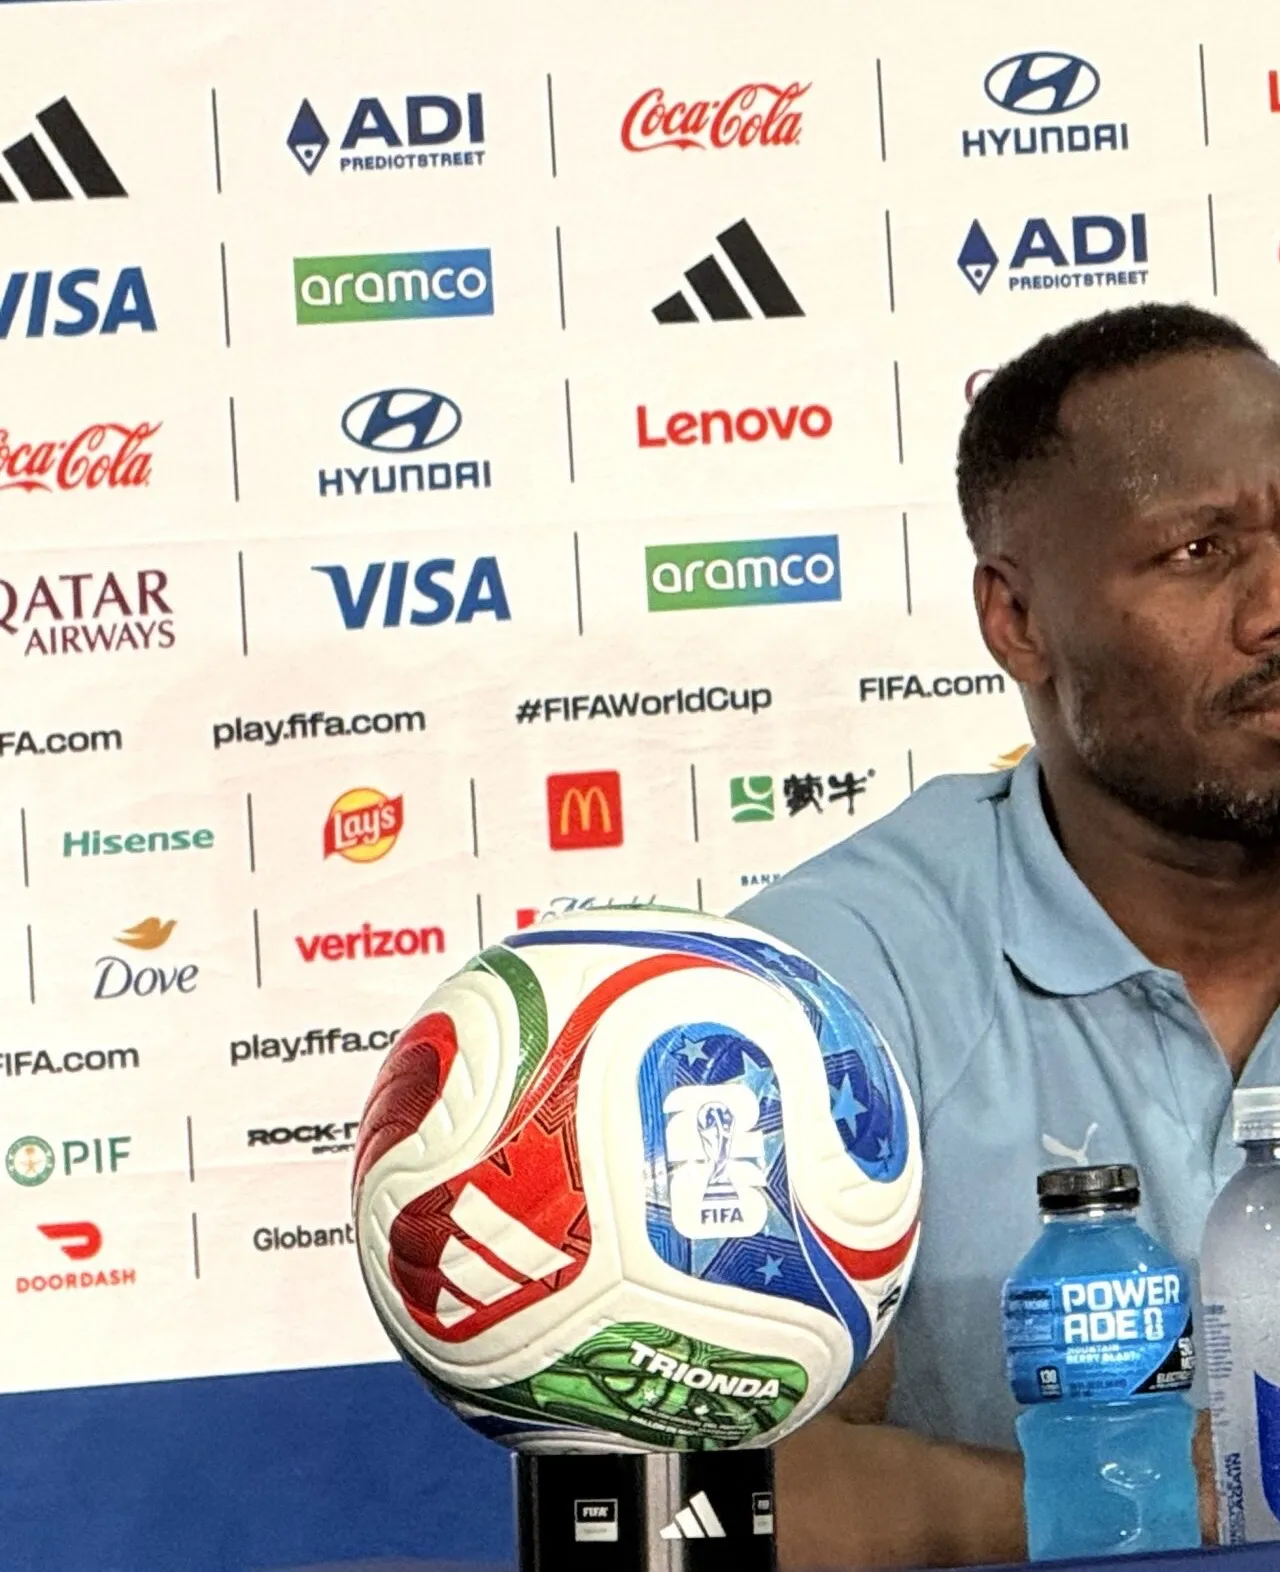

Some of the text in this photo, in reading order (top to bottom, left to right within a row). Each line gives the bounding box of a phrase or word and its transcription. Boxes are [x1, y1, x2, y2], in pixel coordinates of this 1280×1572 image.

[339, 92, 485, 151] ADI
[620, 81, 812, 153] Coca-Cola
[962, 122, 1129, 158] HYUNDAI
[1008, 213, 1149, 270] ADI
[301, 264, 488, 308] aramco
[636, 403, 833, 449] Lenovo
[318, 460, 492, 497] HYUNDAI
[310, 555, 512, 630] VISA
[652, 552, 835, 594] aramco
[24, 619, 176, 656] AIRWAYS
[515, 686, 773, 725] #FIFAWorldCup
[859, 673, 1006, 703] FIFA.com
[0, 729, 123, 758] FA.com
[212, 710, 426, 750] play.fifa.com
[63, 829, 214, 857] Hisense
[294, 922, 446, 963] verizon
[93, 956, 199, 1000] Dove
[229, 1028, 402, 1067] play.fifa.c
[62, 1136, 131, 1176] PIF
[700, 1208, 745, 1226] FIFA
[252, 1223, 356, 1252] Globant
[16, 1269, 136, 1293] DOORDASH
[1061, 1274, 1181, 1313] POWER
[1064, 1309, 1138, 1344] ADE
[630, 1340, 780, 1400] TRIONDA
